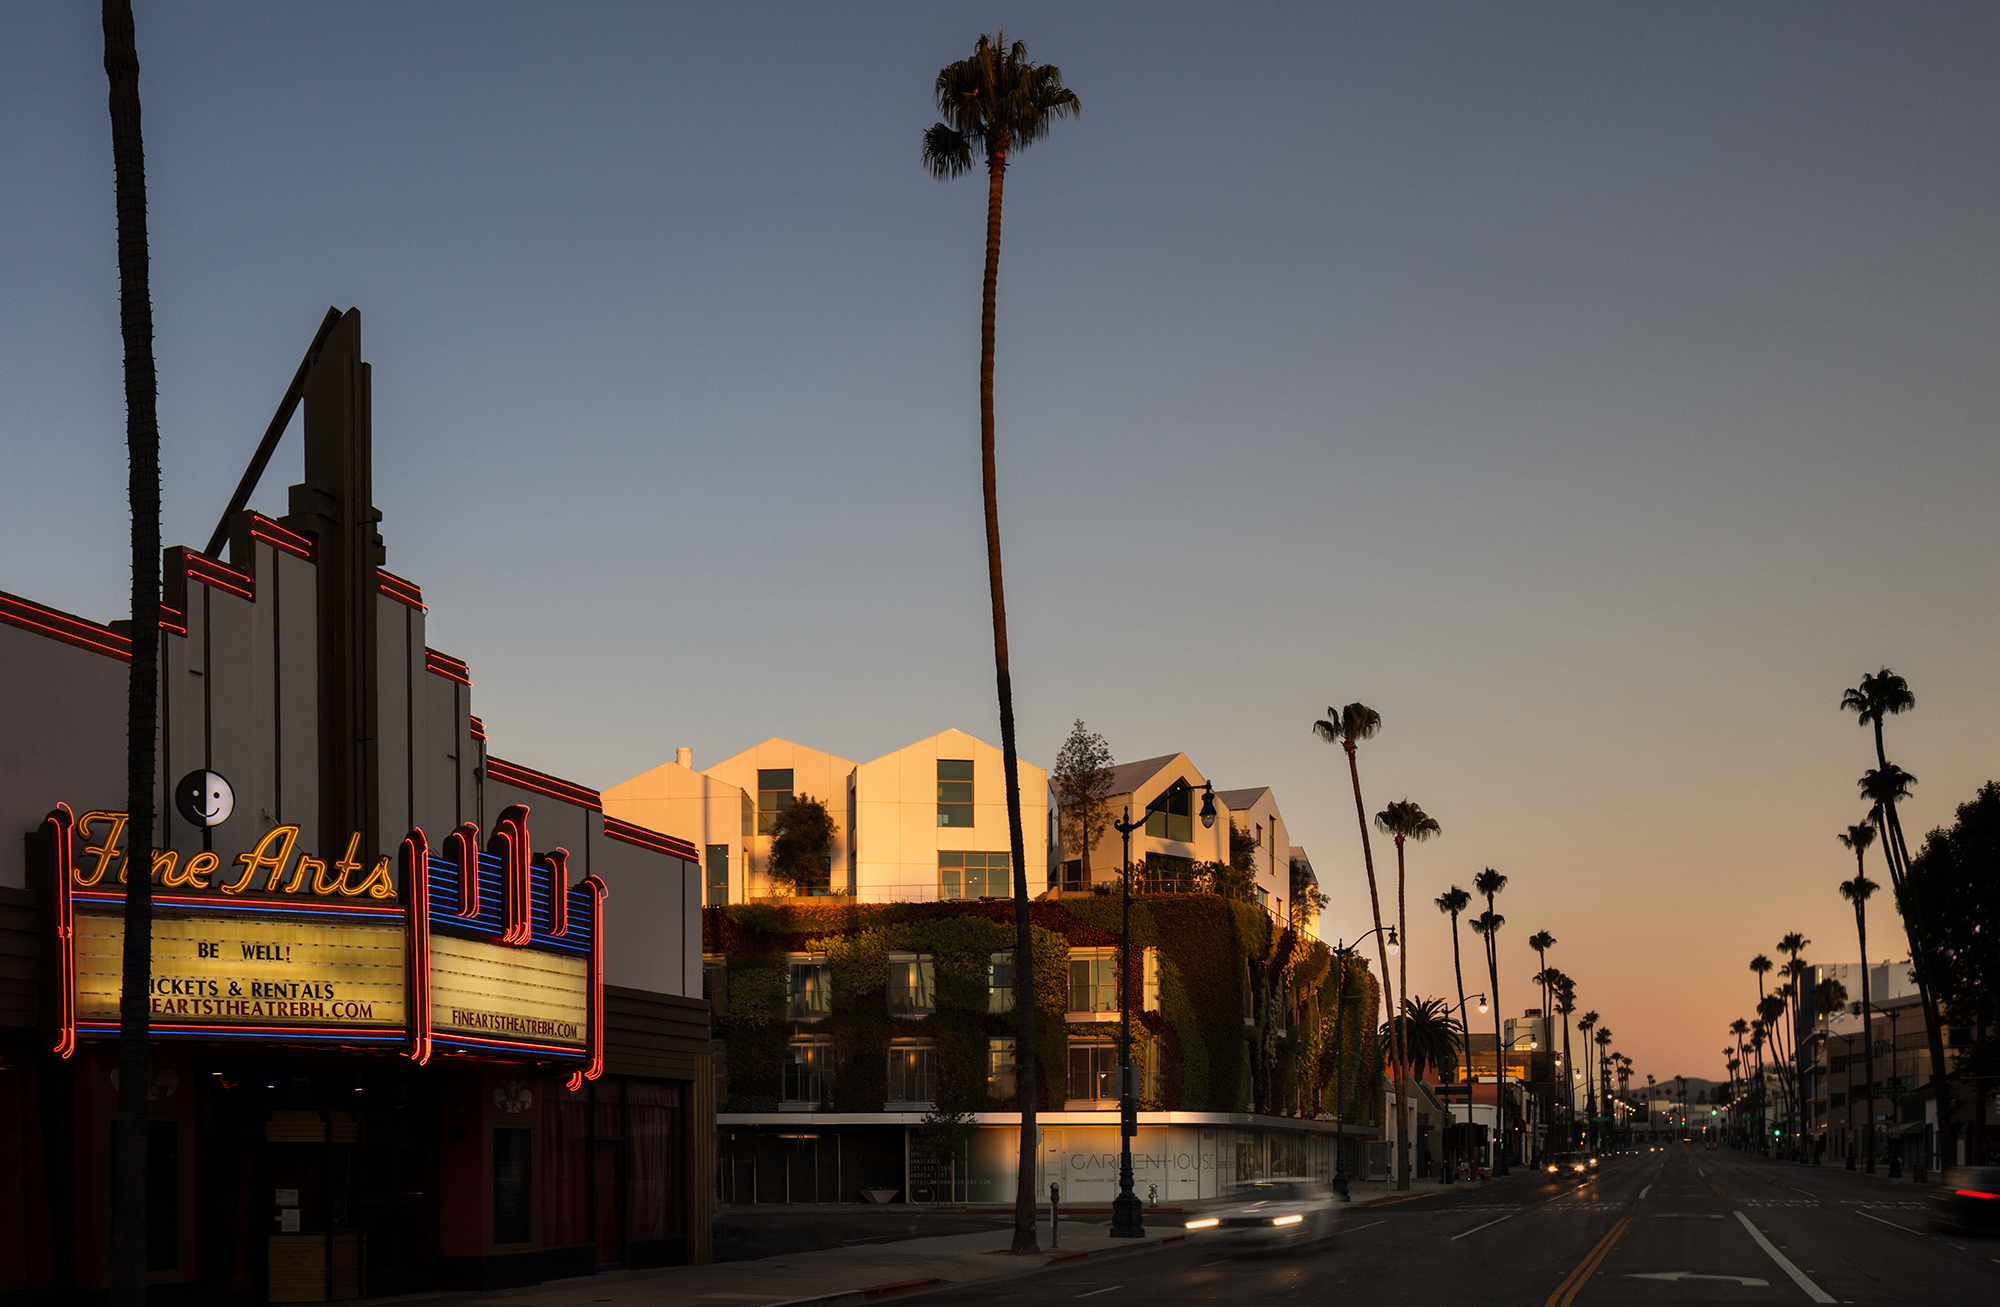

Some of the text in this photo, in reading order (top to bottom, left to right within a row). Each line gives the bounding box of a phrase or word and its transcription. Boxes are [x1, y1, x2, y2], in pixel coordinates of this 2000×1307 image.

[219, 823, 399, 899] Arts
[198, 942, 292, 962] BE WELL!
[150, 978, 335, 1000] ICKETS & RENTALS
[119, 996, 373, 1019] EARTSTHEATREBH.COM
[452, 1009, 577, 1039] FINEARTSTHEATREBH.COM
